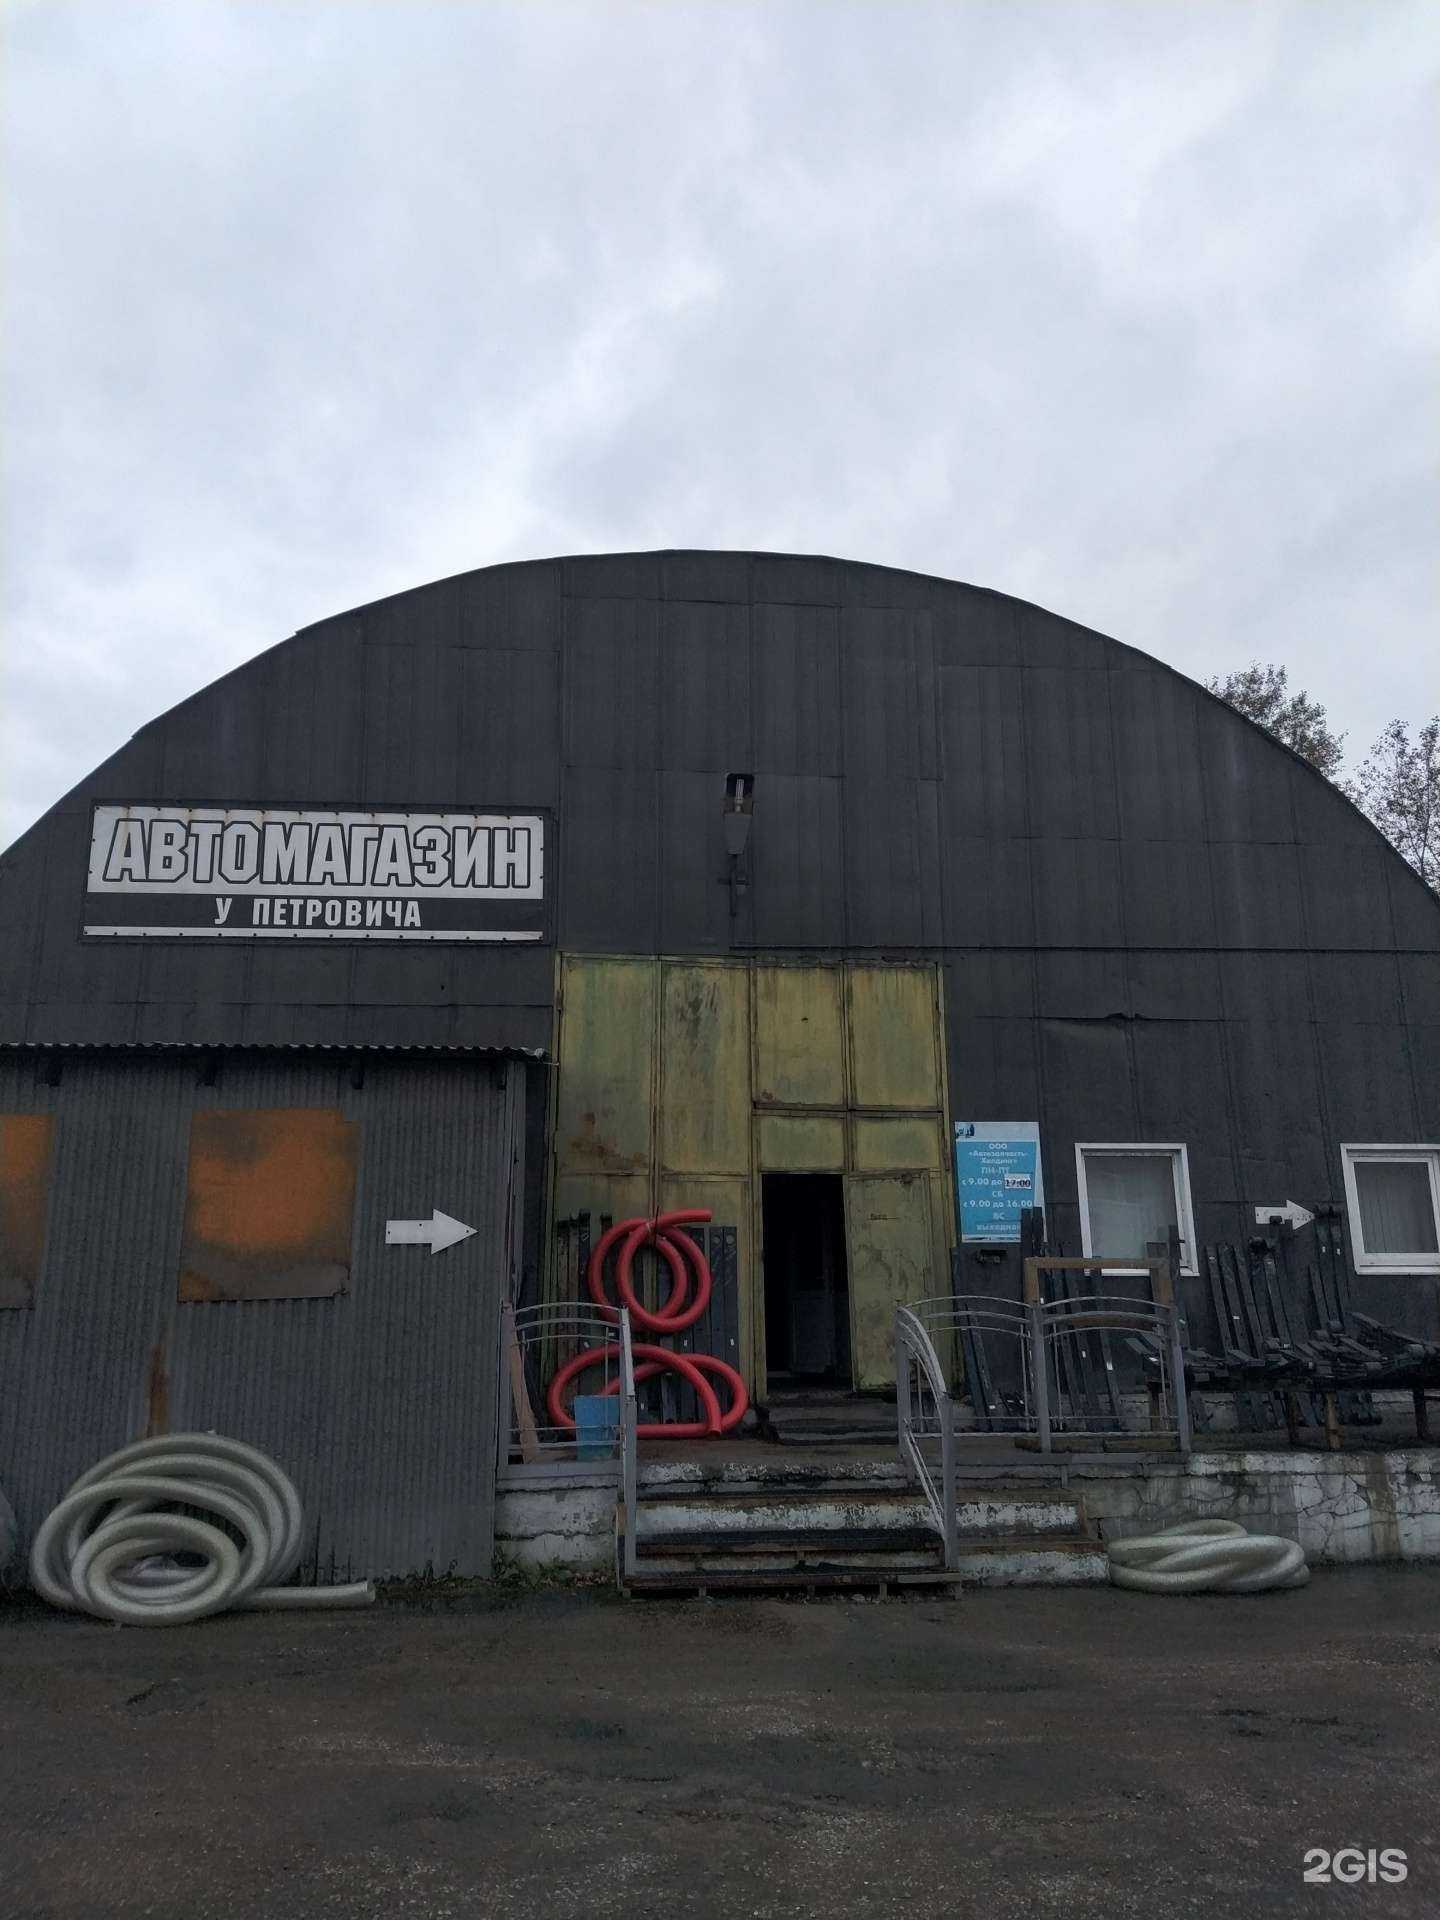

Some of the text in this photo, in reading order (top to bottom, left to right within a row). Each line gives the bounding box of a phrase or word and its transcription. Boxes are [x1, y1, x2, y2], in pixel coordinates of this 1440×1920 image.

[102, 818, 531, 889] АВТОМАГАЗИН
[214, 897, 422, 928] У ПЕТРОВИЧА
